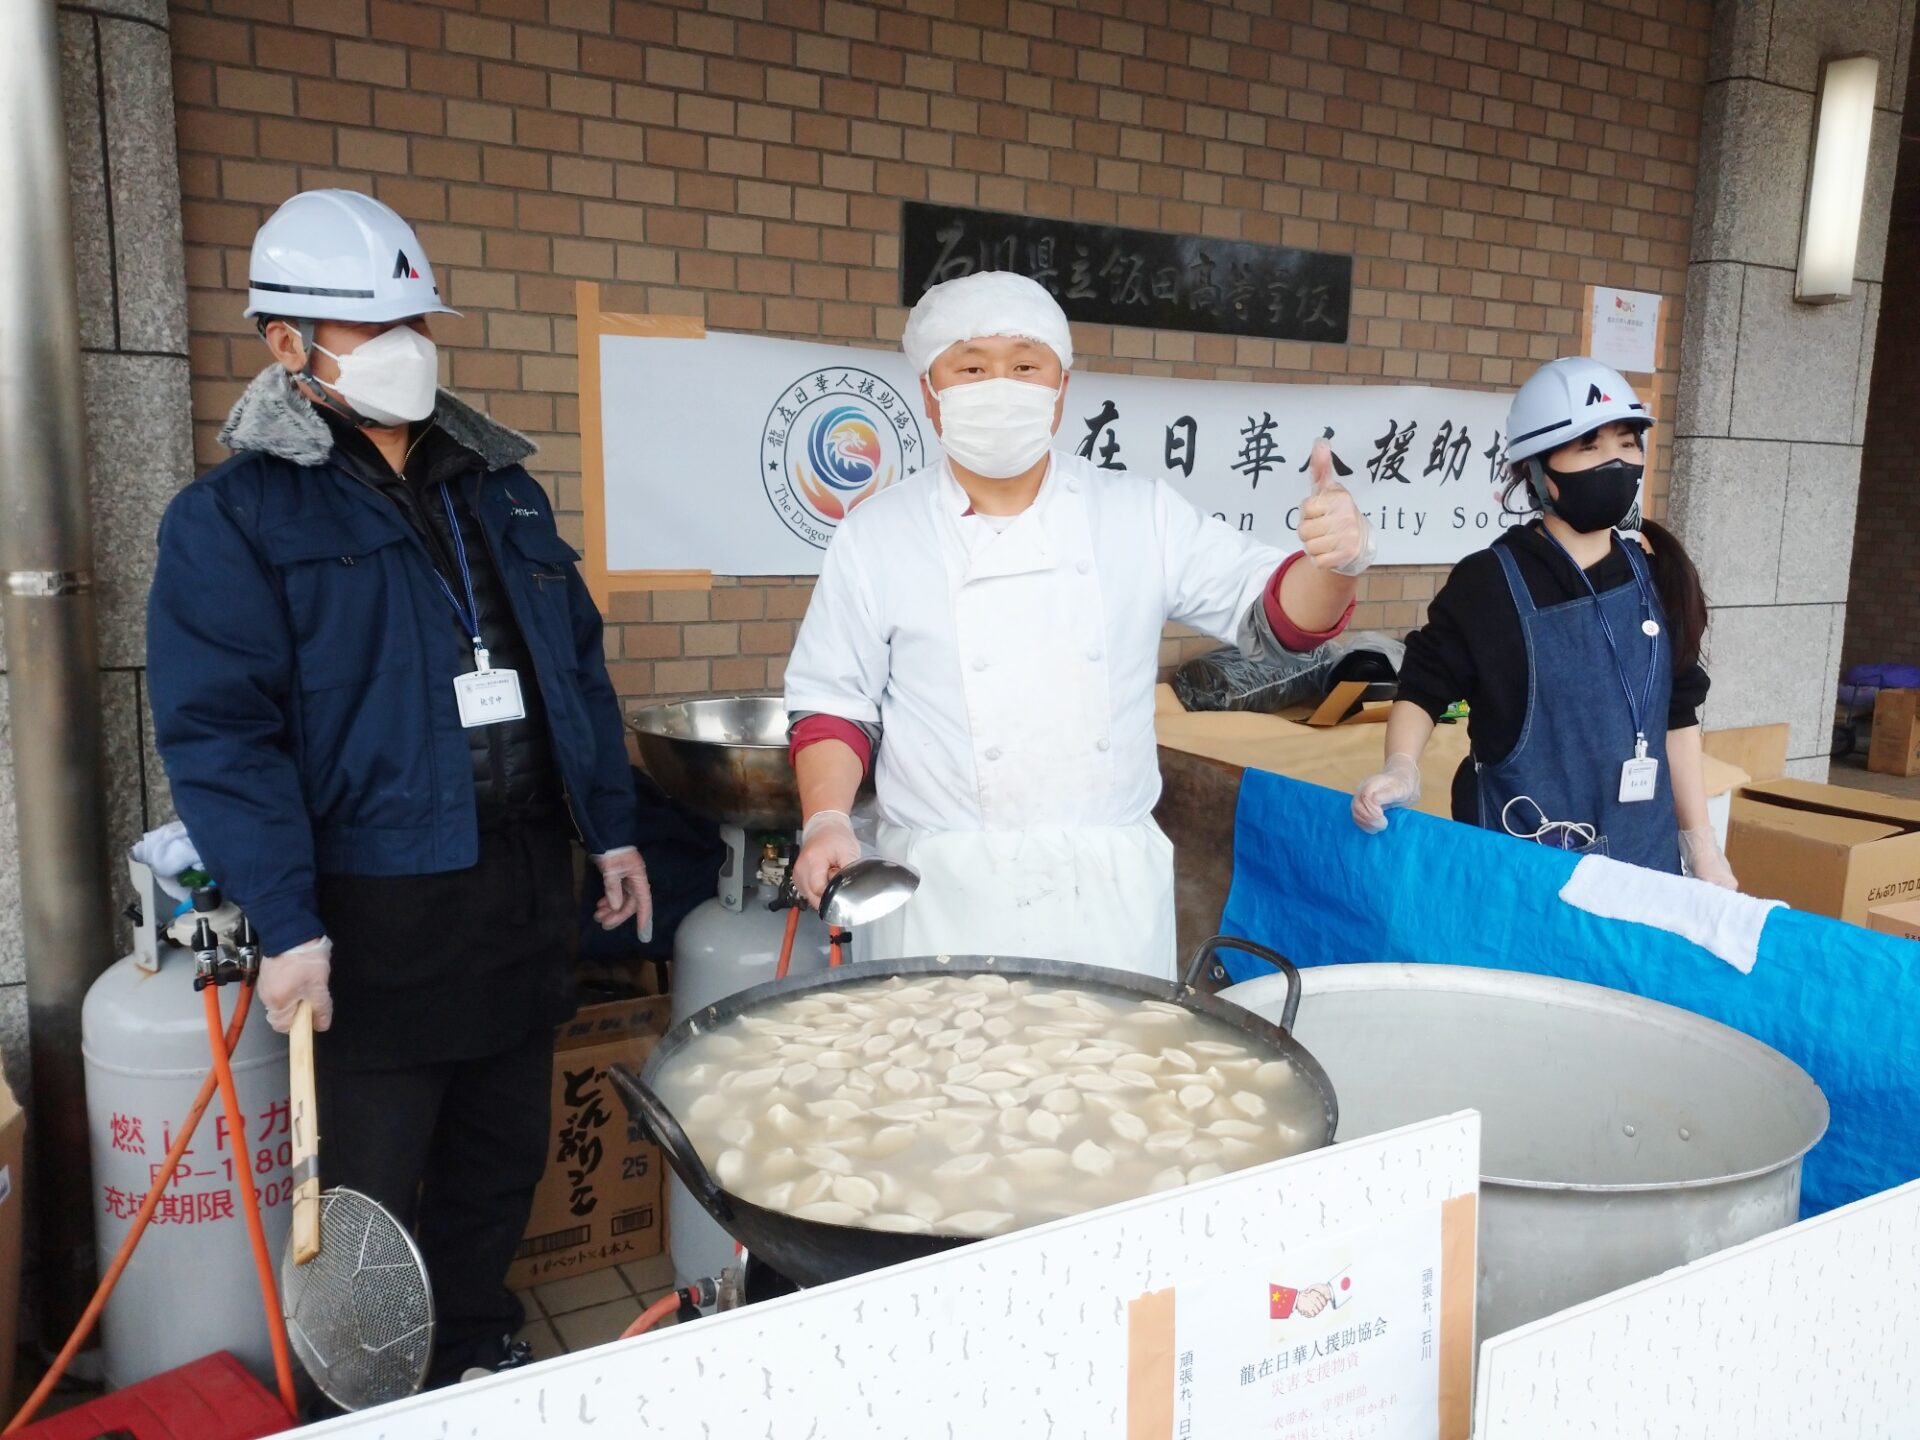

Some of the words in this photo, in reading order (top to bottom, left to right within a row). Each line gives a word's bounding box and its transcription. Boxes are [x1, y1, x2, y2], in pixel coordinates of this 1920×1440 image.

[923, 221, 1337, 328] 石川県立飯田高等学校
[774, 483, 792, 512] The
[1285, 505, 1427, 536] Crity
[622, 1154, 648, 1181] 25
[1239, 1316, 1388, 1387] 龍在日華人援助協会
